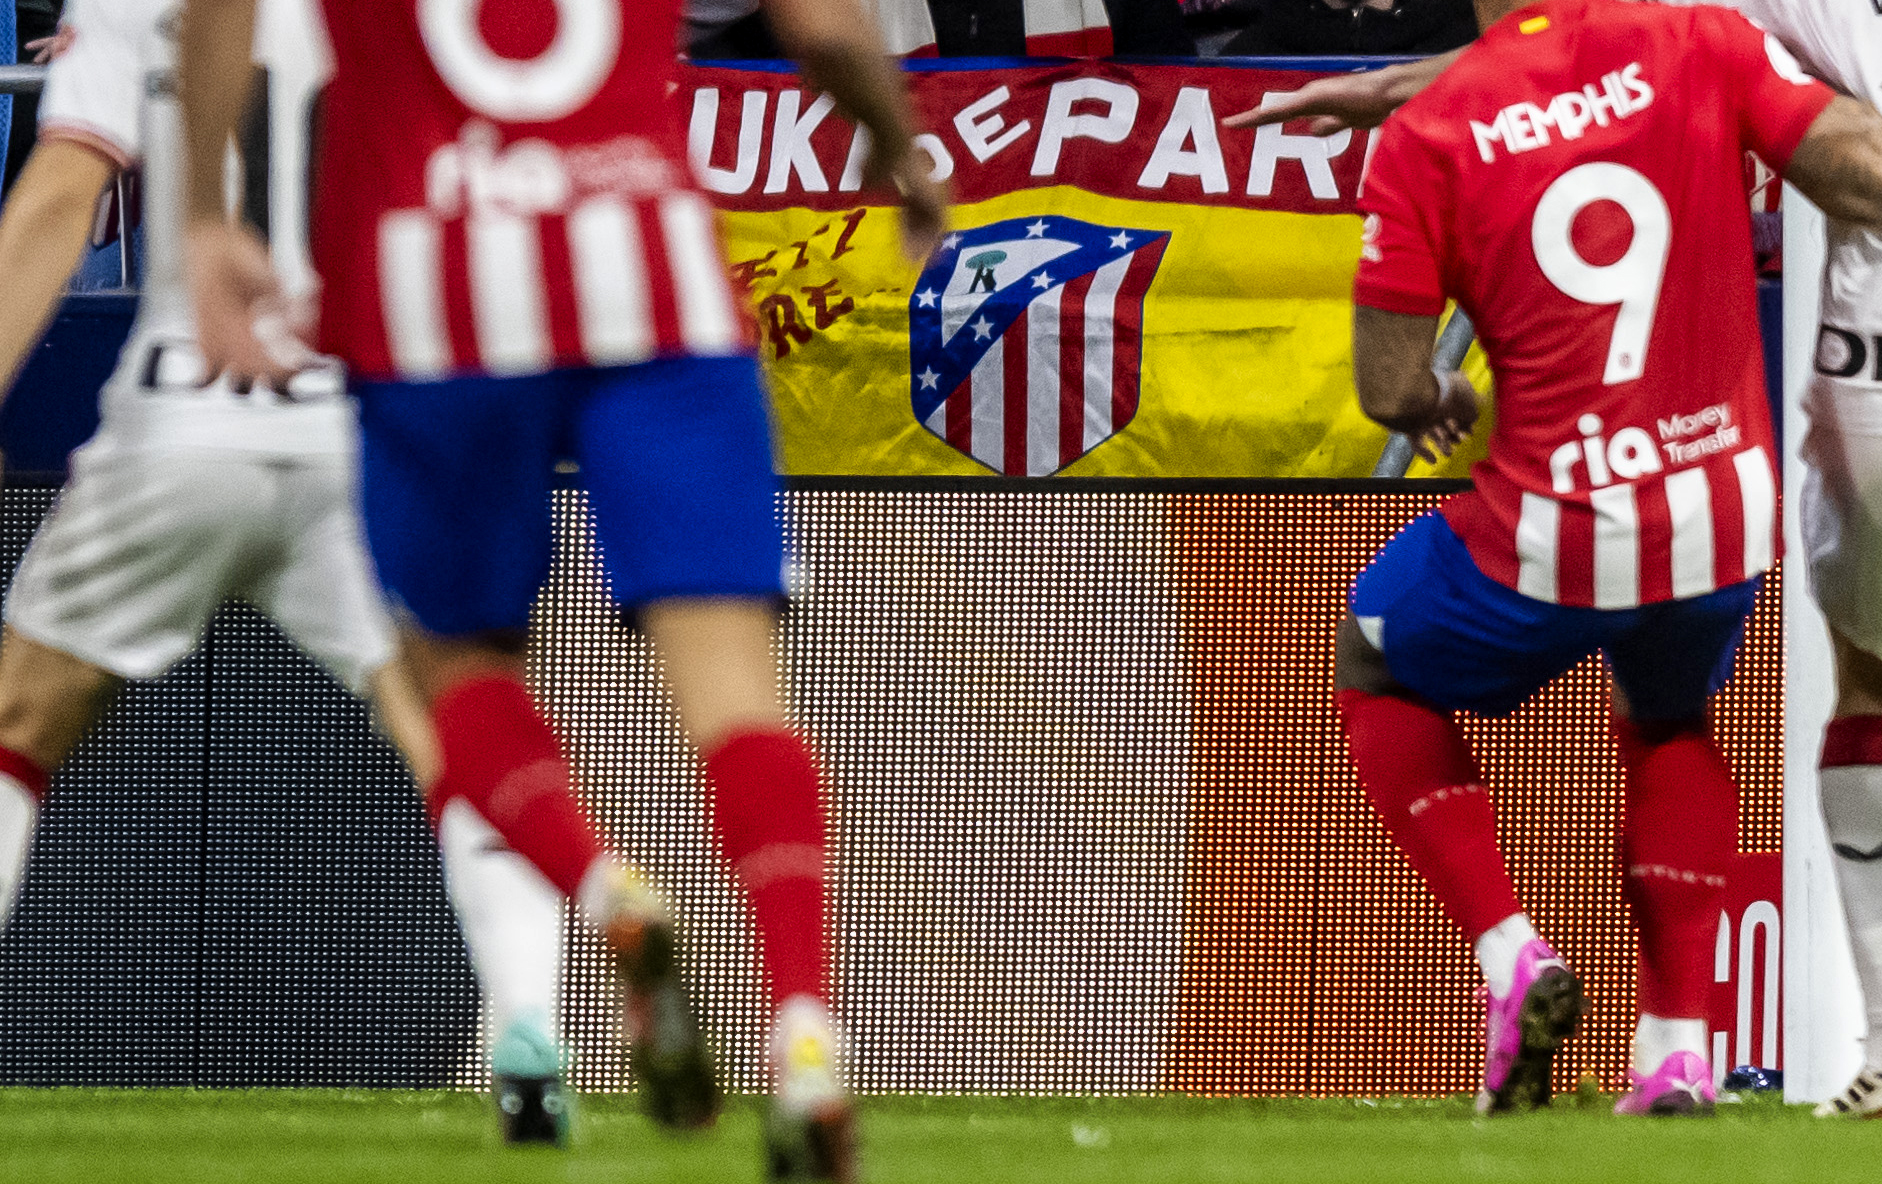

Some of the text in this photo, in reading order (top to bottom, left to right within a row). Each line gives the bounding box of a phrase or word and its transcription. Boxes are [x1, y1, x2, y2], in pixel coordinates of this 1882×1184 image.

[1030, 76, 1378, 200] PAR
[1470, 61, 1655, 164] MEMPHIS
[1532, 162, 1671, 385] 9
[1549, 413, 1664, 493] ria
